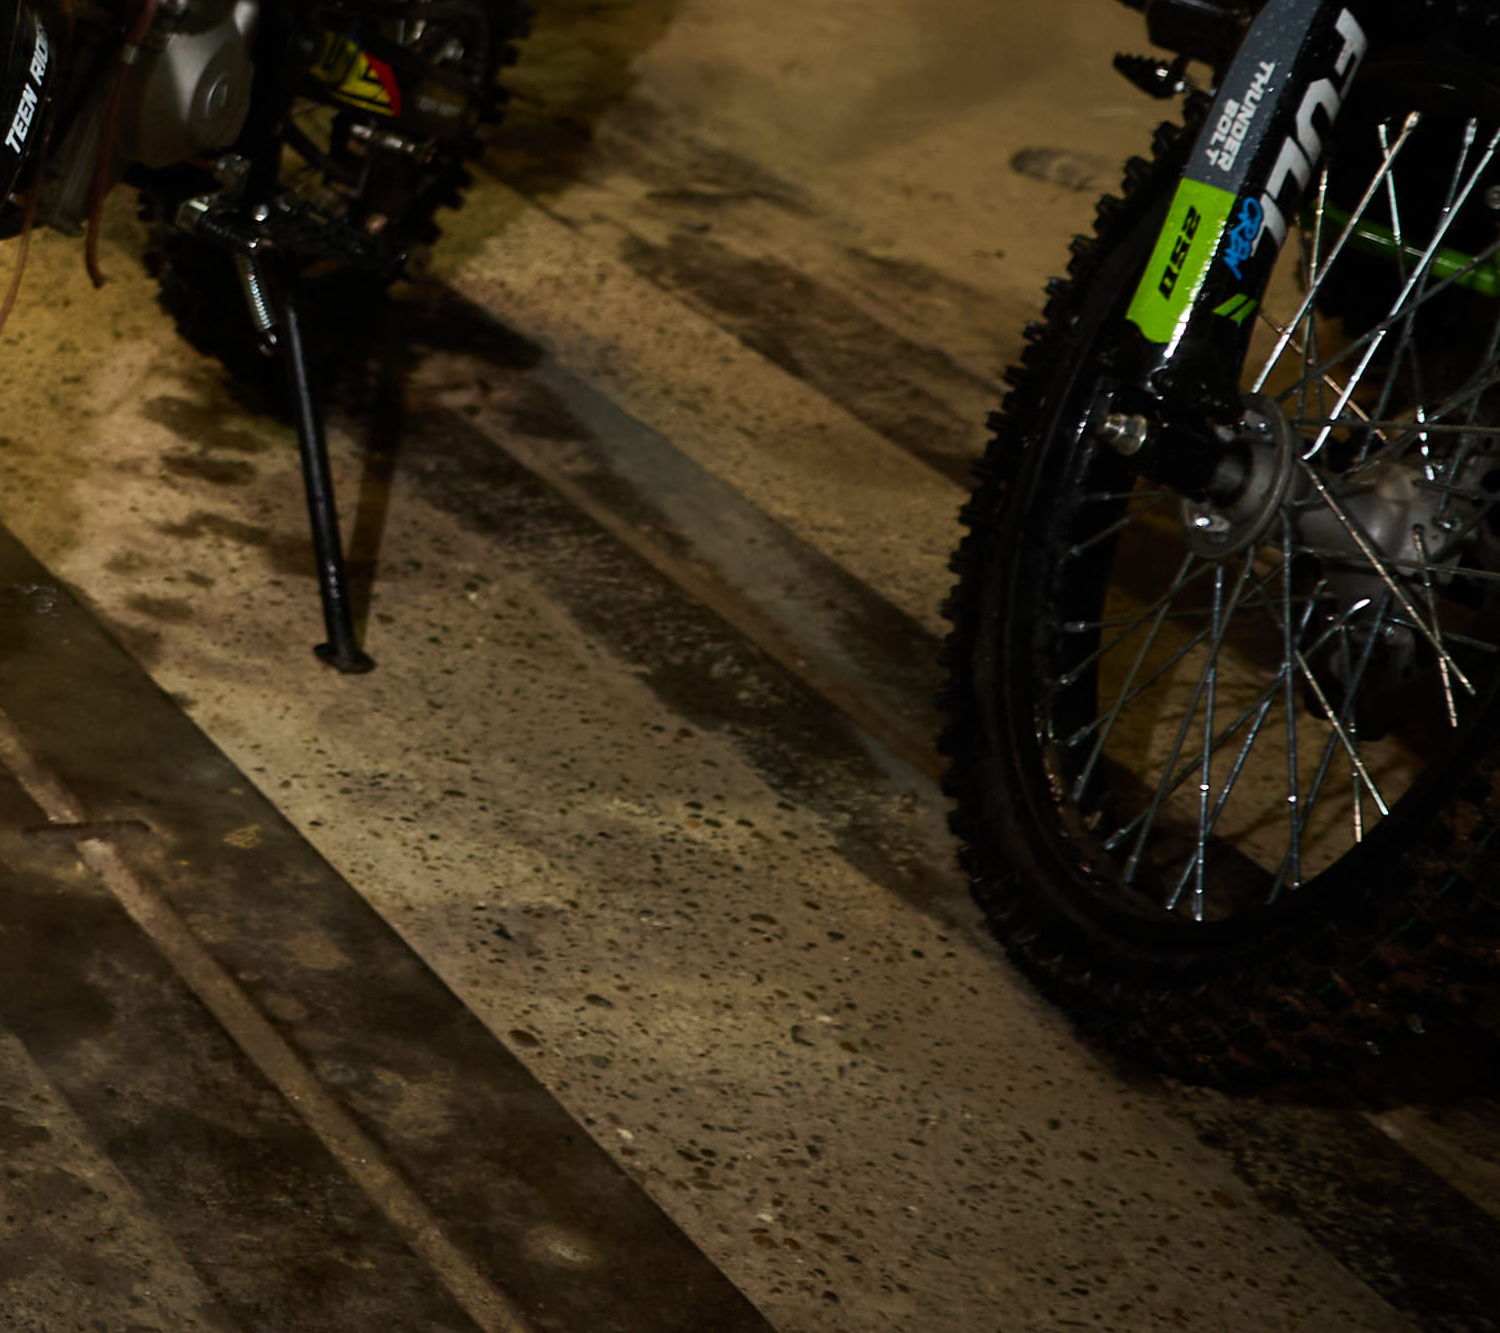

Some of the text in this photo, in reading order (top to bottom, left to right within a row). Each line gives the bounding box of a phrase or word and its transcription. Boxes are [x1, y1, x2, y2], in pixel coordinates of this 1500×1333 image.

[5, 83, 37, 155] TEEN
[1205, 98, 1240, 167] BOLT
[1217, 60, 1276, 173] THUNDER
[1252, 7, 1368, 257] FULL
[1158, 204, 1202, 301] 250
[1224, 197, 1265, 281] CREW
